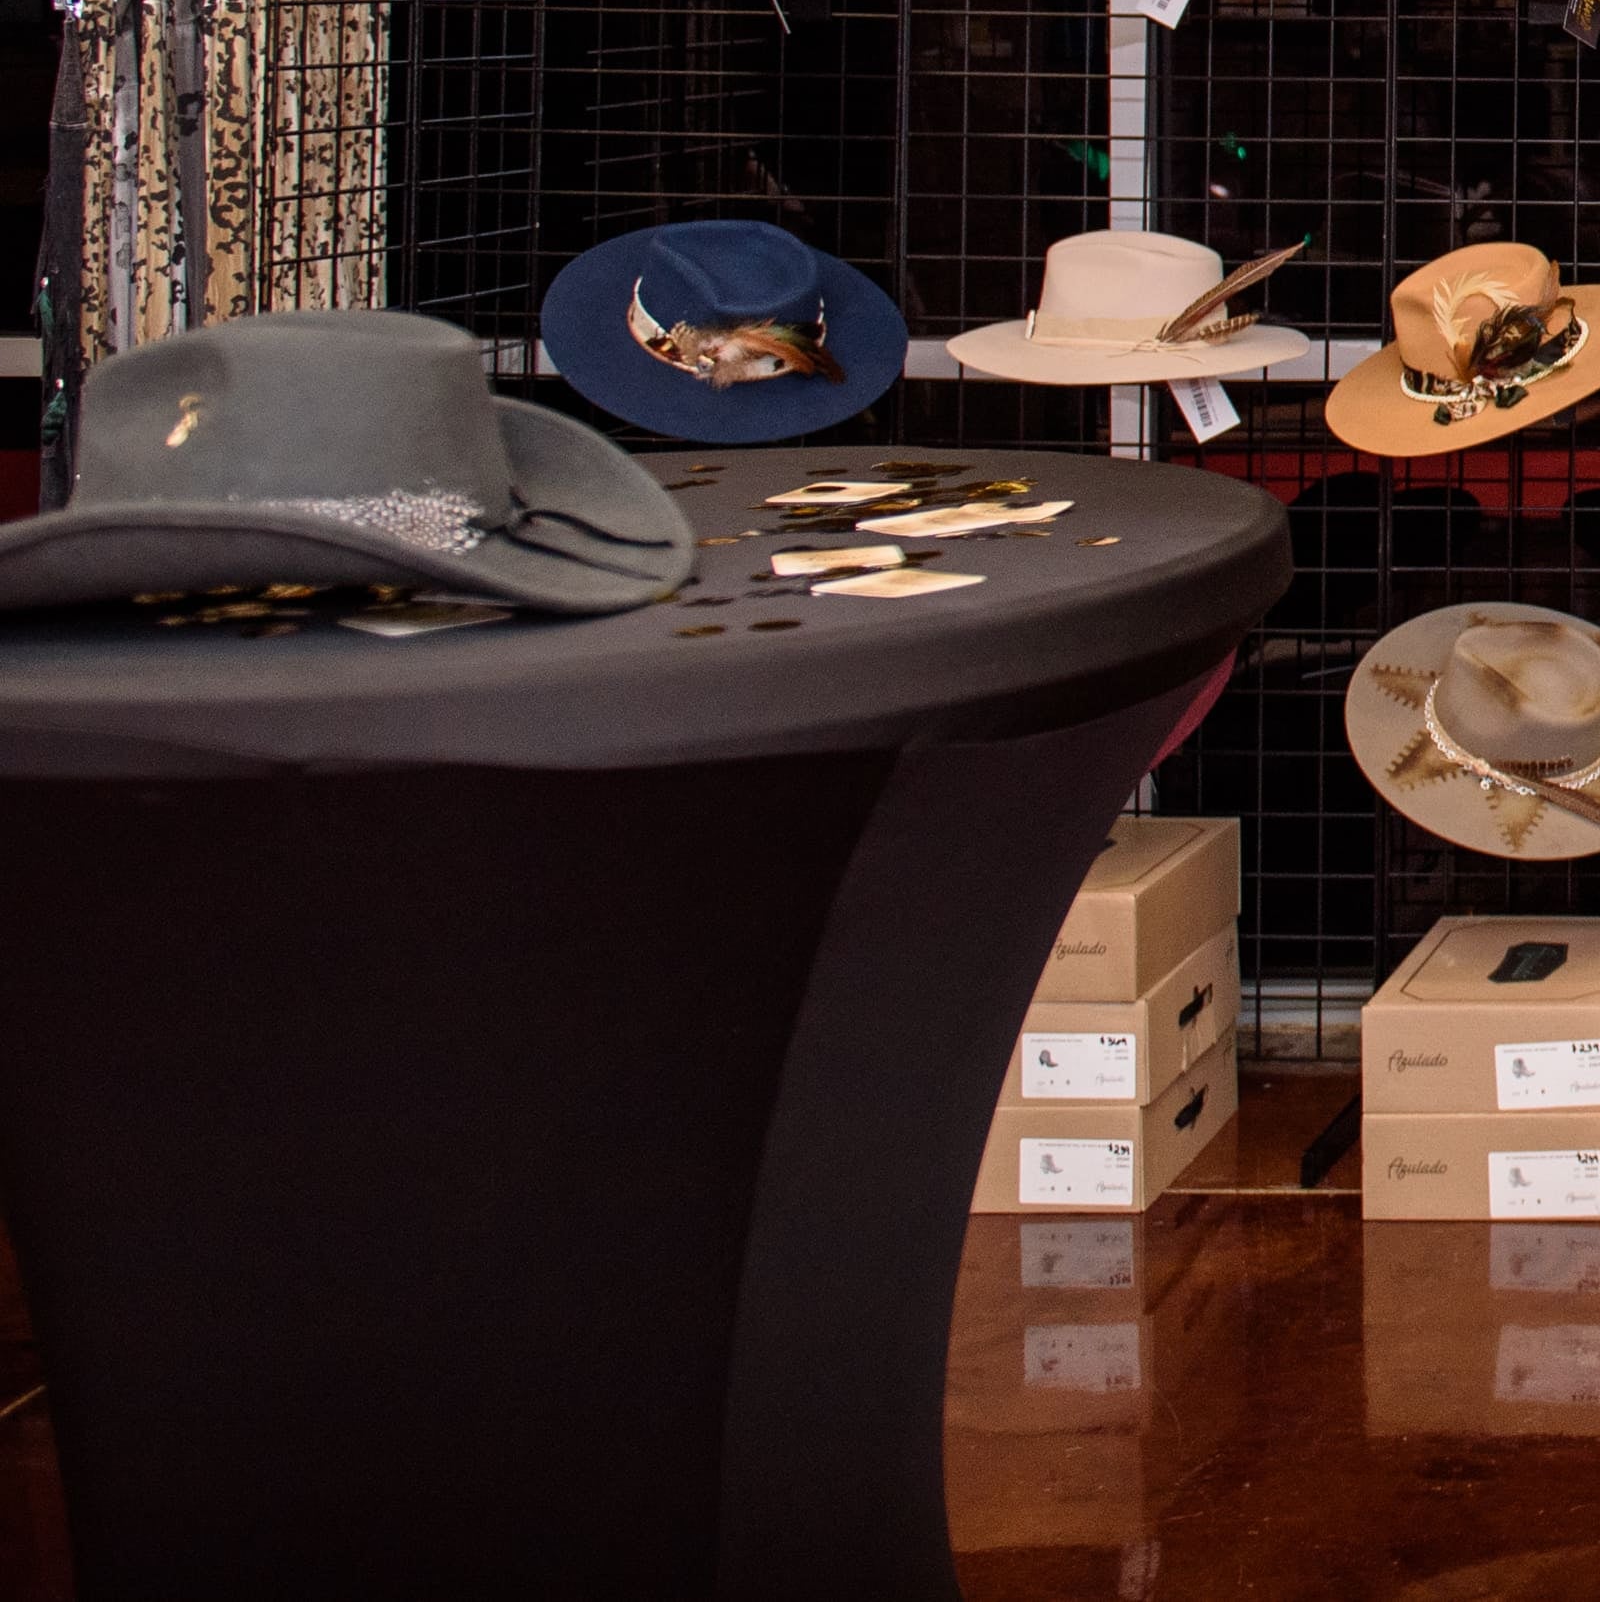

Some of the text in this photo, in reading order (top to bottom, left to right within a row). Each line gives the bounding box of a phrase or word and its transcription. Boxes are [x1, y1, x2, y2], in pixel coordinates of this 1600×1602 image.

[1571, 1043, 1600, 1054] $239
[1388, 1049, 1448, 1072] Azulado
[1387, 1156, 1447, 1180] Azulado
